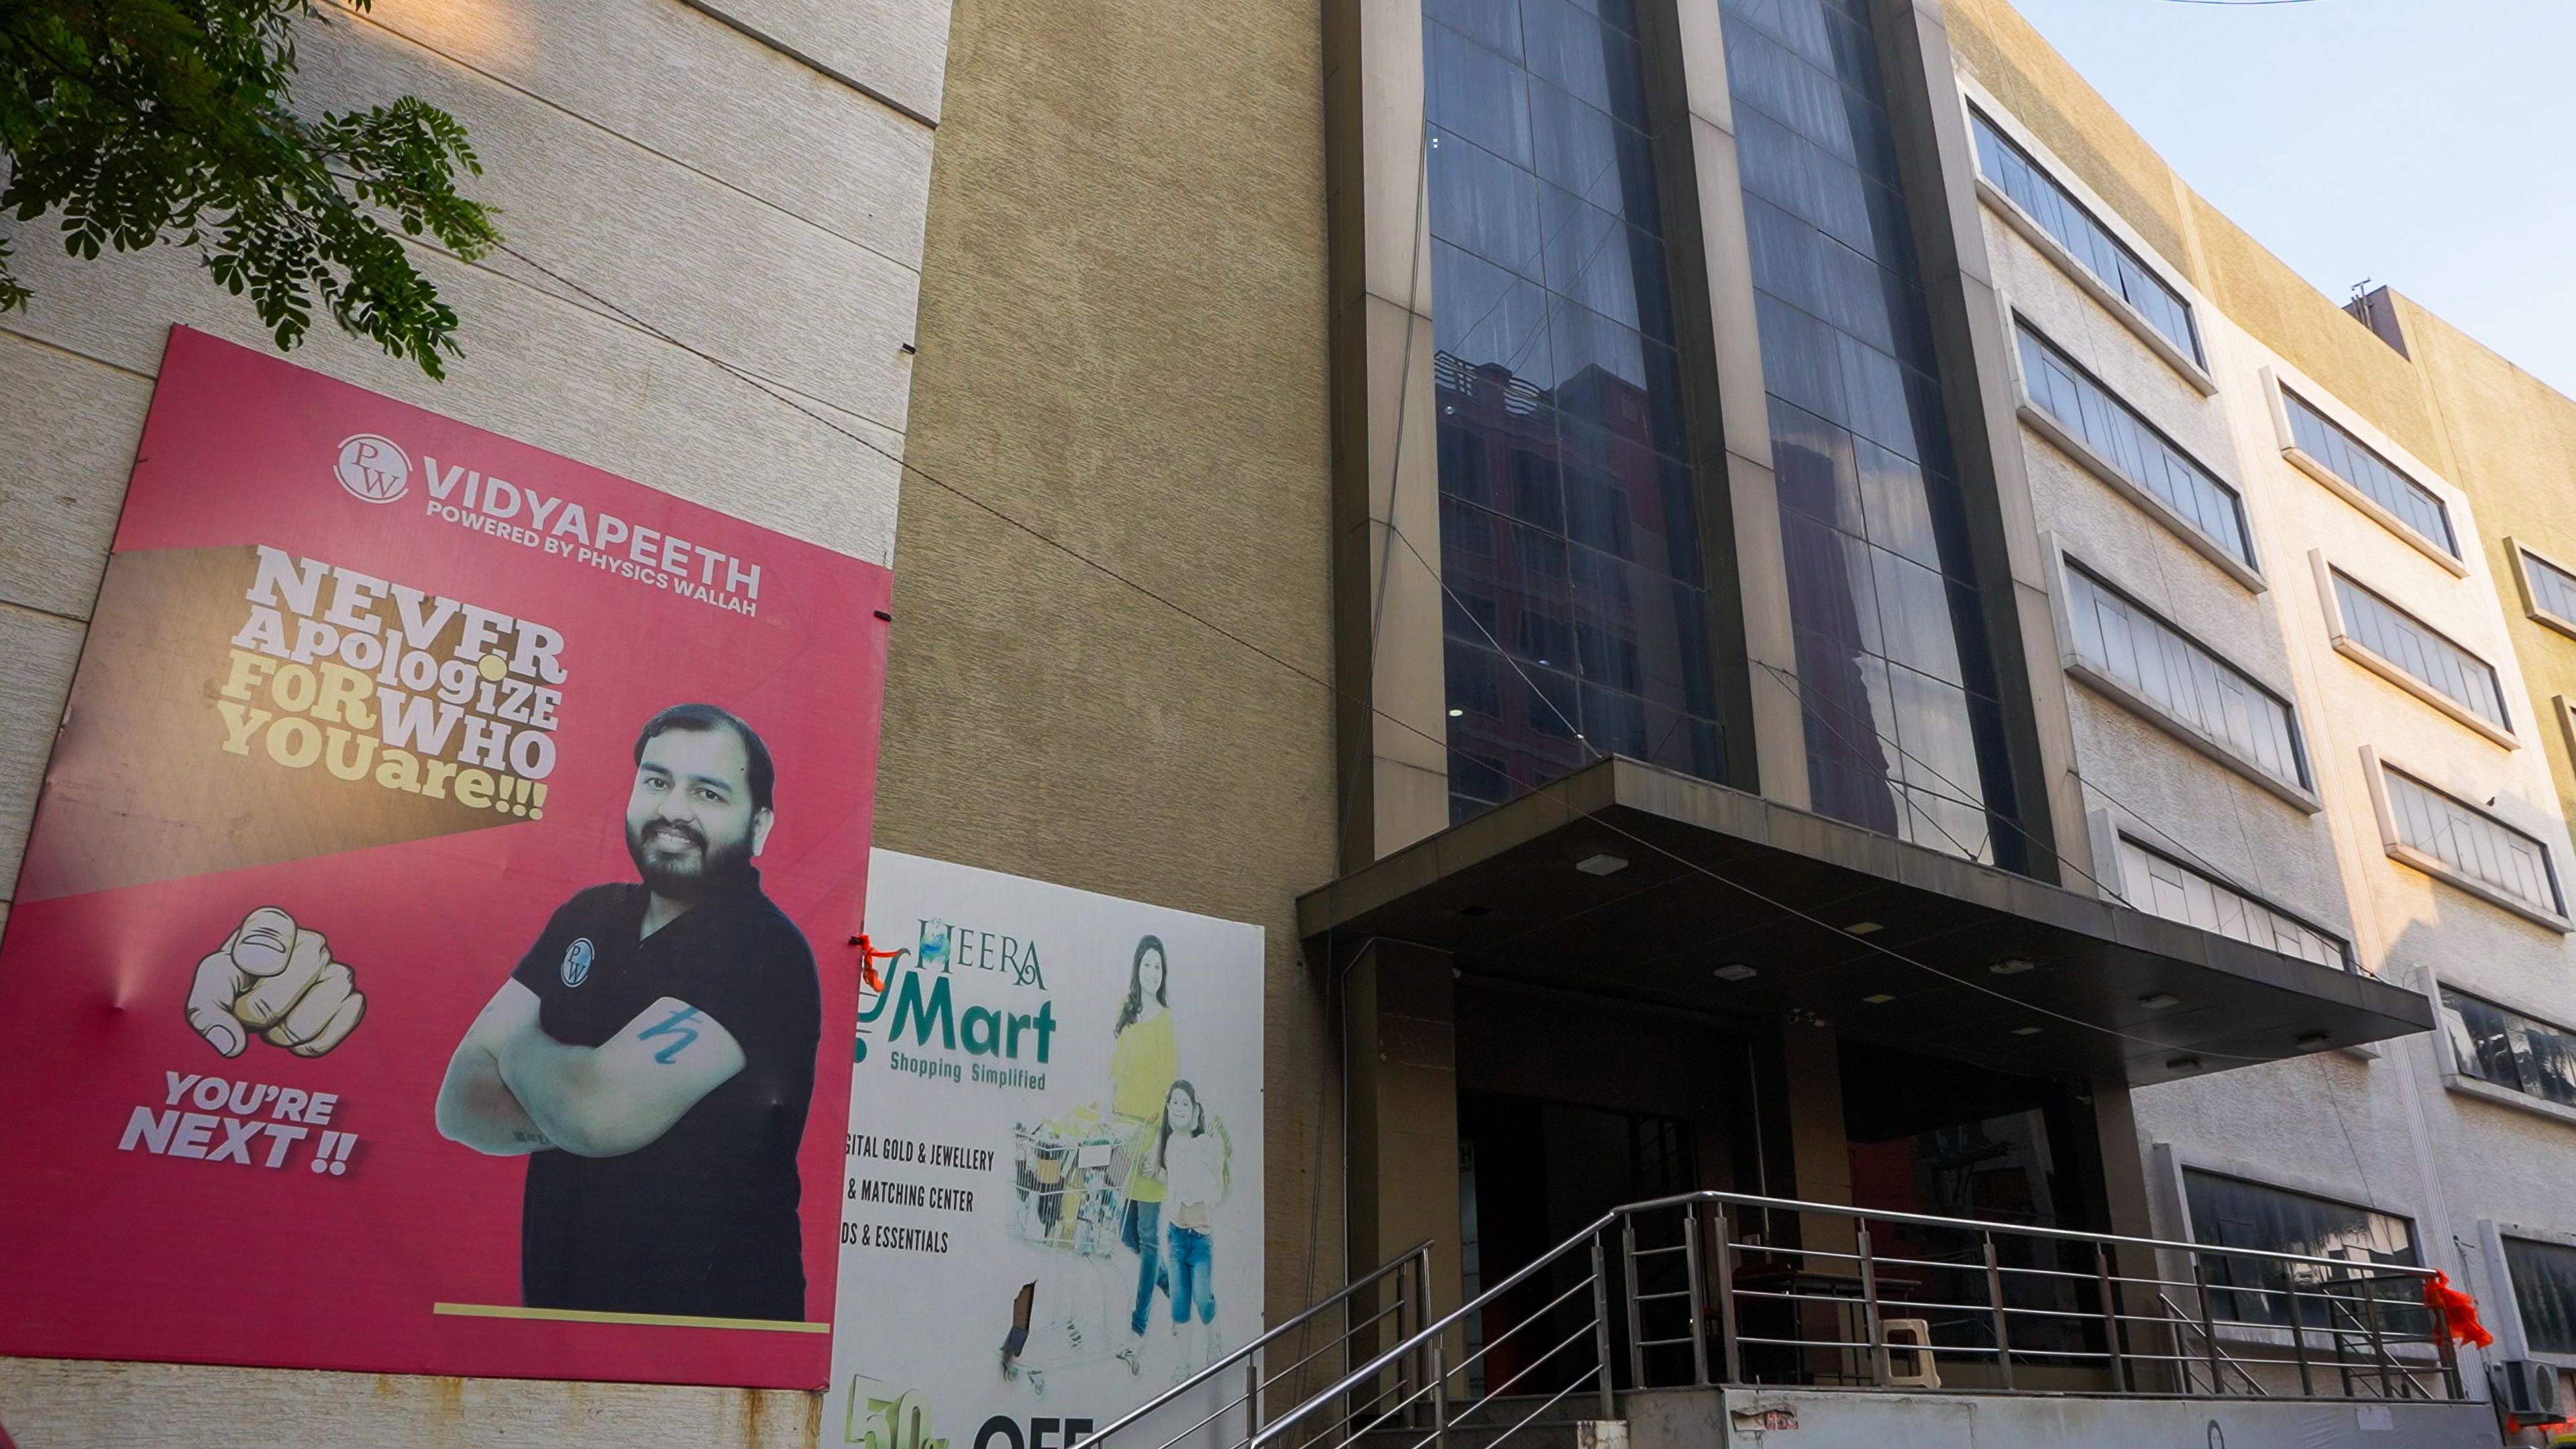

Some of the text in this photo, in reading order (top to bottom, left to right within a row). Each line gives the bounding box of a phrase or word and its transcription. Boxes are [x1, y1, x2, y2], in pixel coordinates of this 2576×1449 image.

[423, 455, 761, 600] VIDYAPEETH
[426, 500, 757, 617] POWERED BY PHYSICS WALLAH
[246, 544, 568, 684] NEVER
[217, 700, 380, 781] YOU
[220, 648, 556, 780] FOR WHO
[914, 918, 1049, 991] HEERA
[888, 970, 1057, 1064] Mart
[165, 1071, 339, 1125] YOU’RE
[890, 1051, 1046, 1091] Shopping Simplified
[117, 1106, 309, 1169] NEXT
[883, 1138, 914, 1162] GOLD
[917, 1142, 926, 1164] &
[930, 1144, 995, 1171] JEWELLERY
[847, 1178, 973, 1212] & MATCHING CENTER
[862, 1224, 870, 1246] &
[875, 1225, 949, 1253] ESSENTIALS
[845, 1373, 950, 1449] 50
